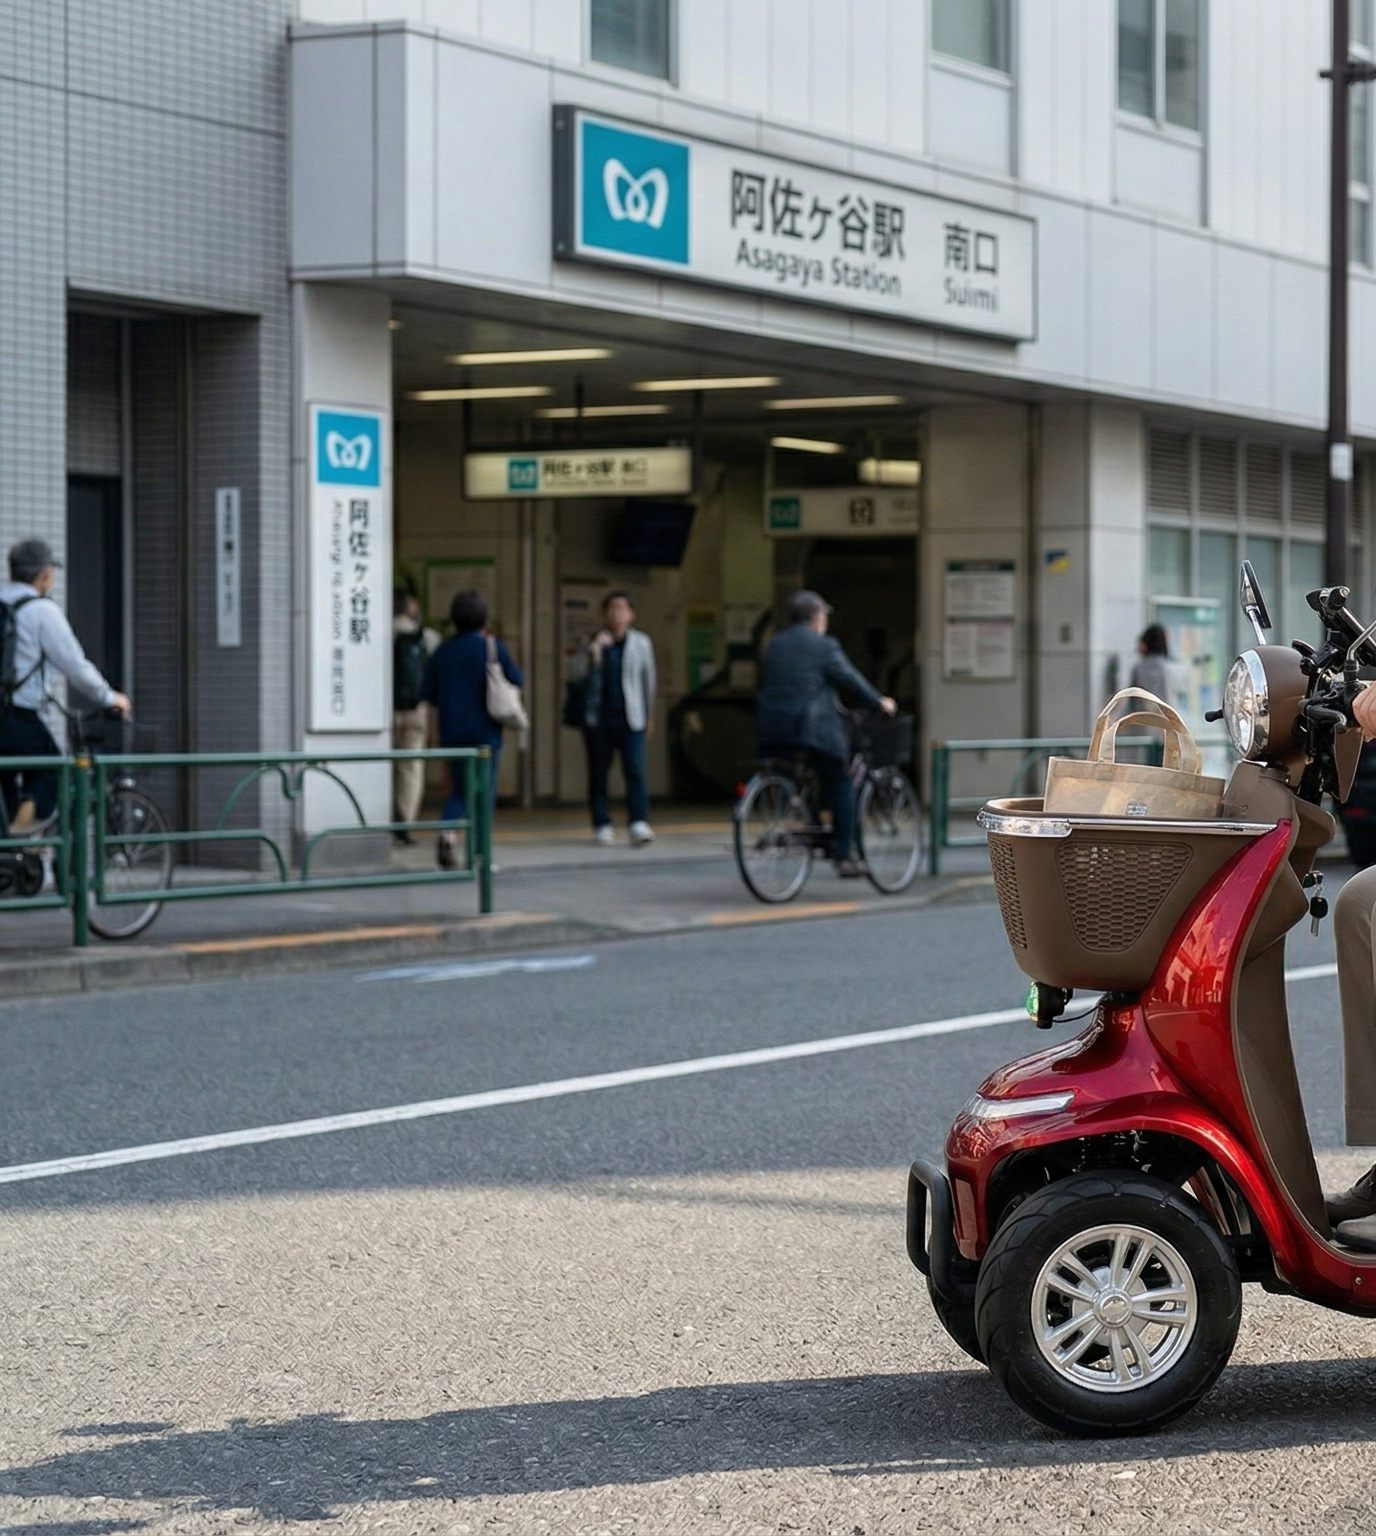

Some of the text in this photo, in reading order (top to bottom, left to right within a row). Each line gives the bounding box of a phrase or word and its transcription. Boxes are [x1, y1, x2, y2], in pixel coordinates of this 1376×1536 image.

[735, 238, 902, 297] Asagaya Station
[943, 221, 999, 276] 南口
